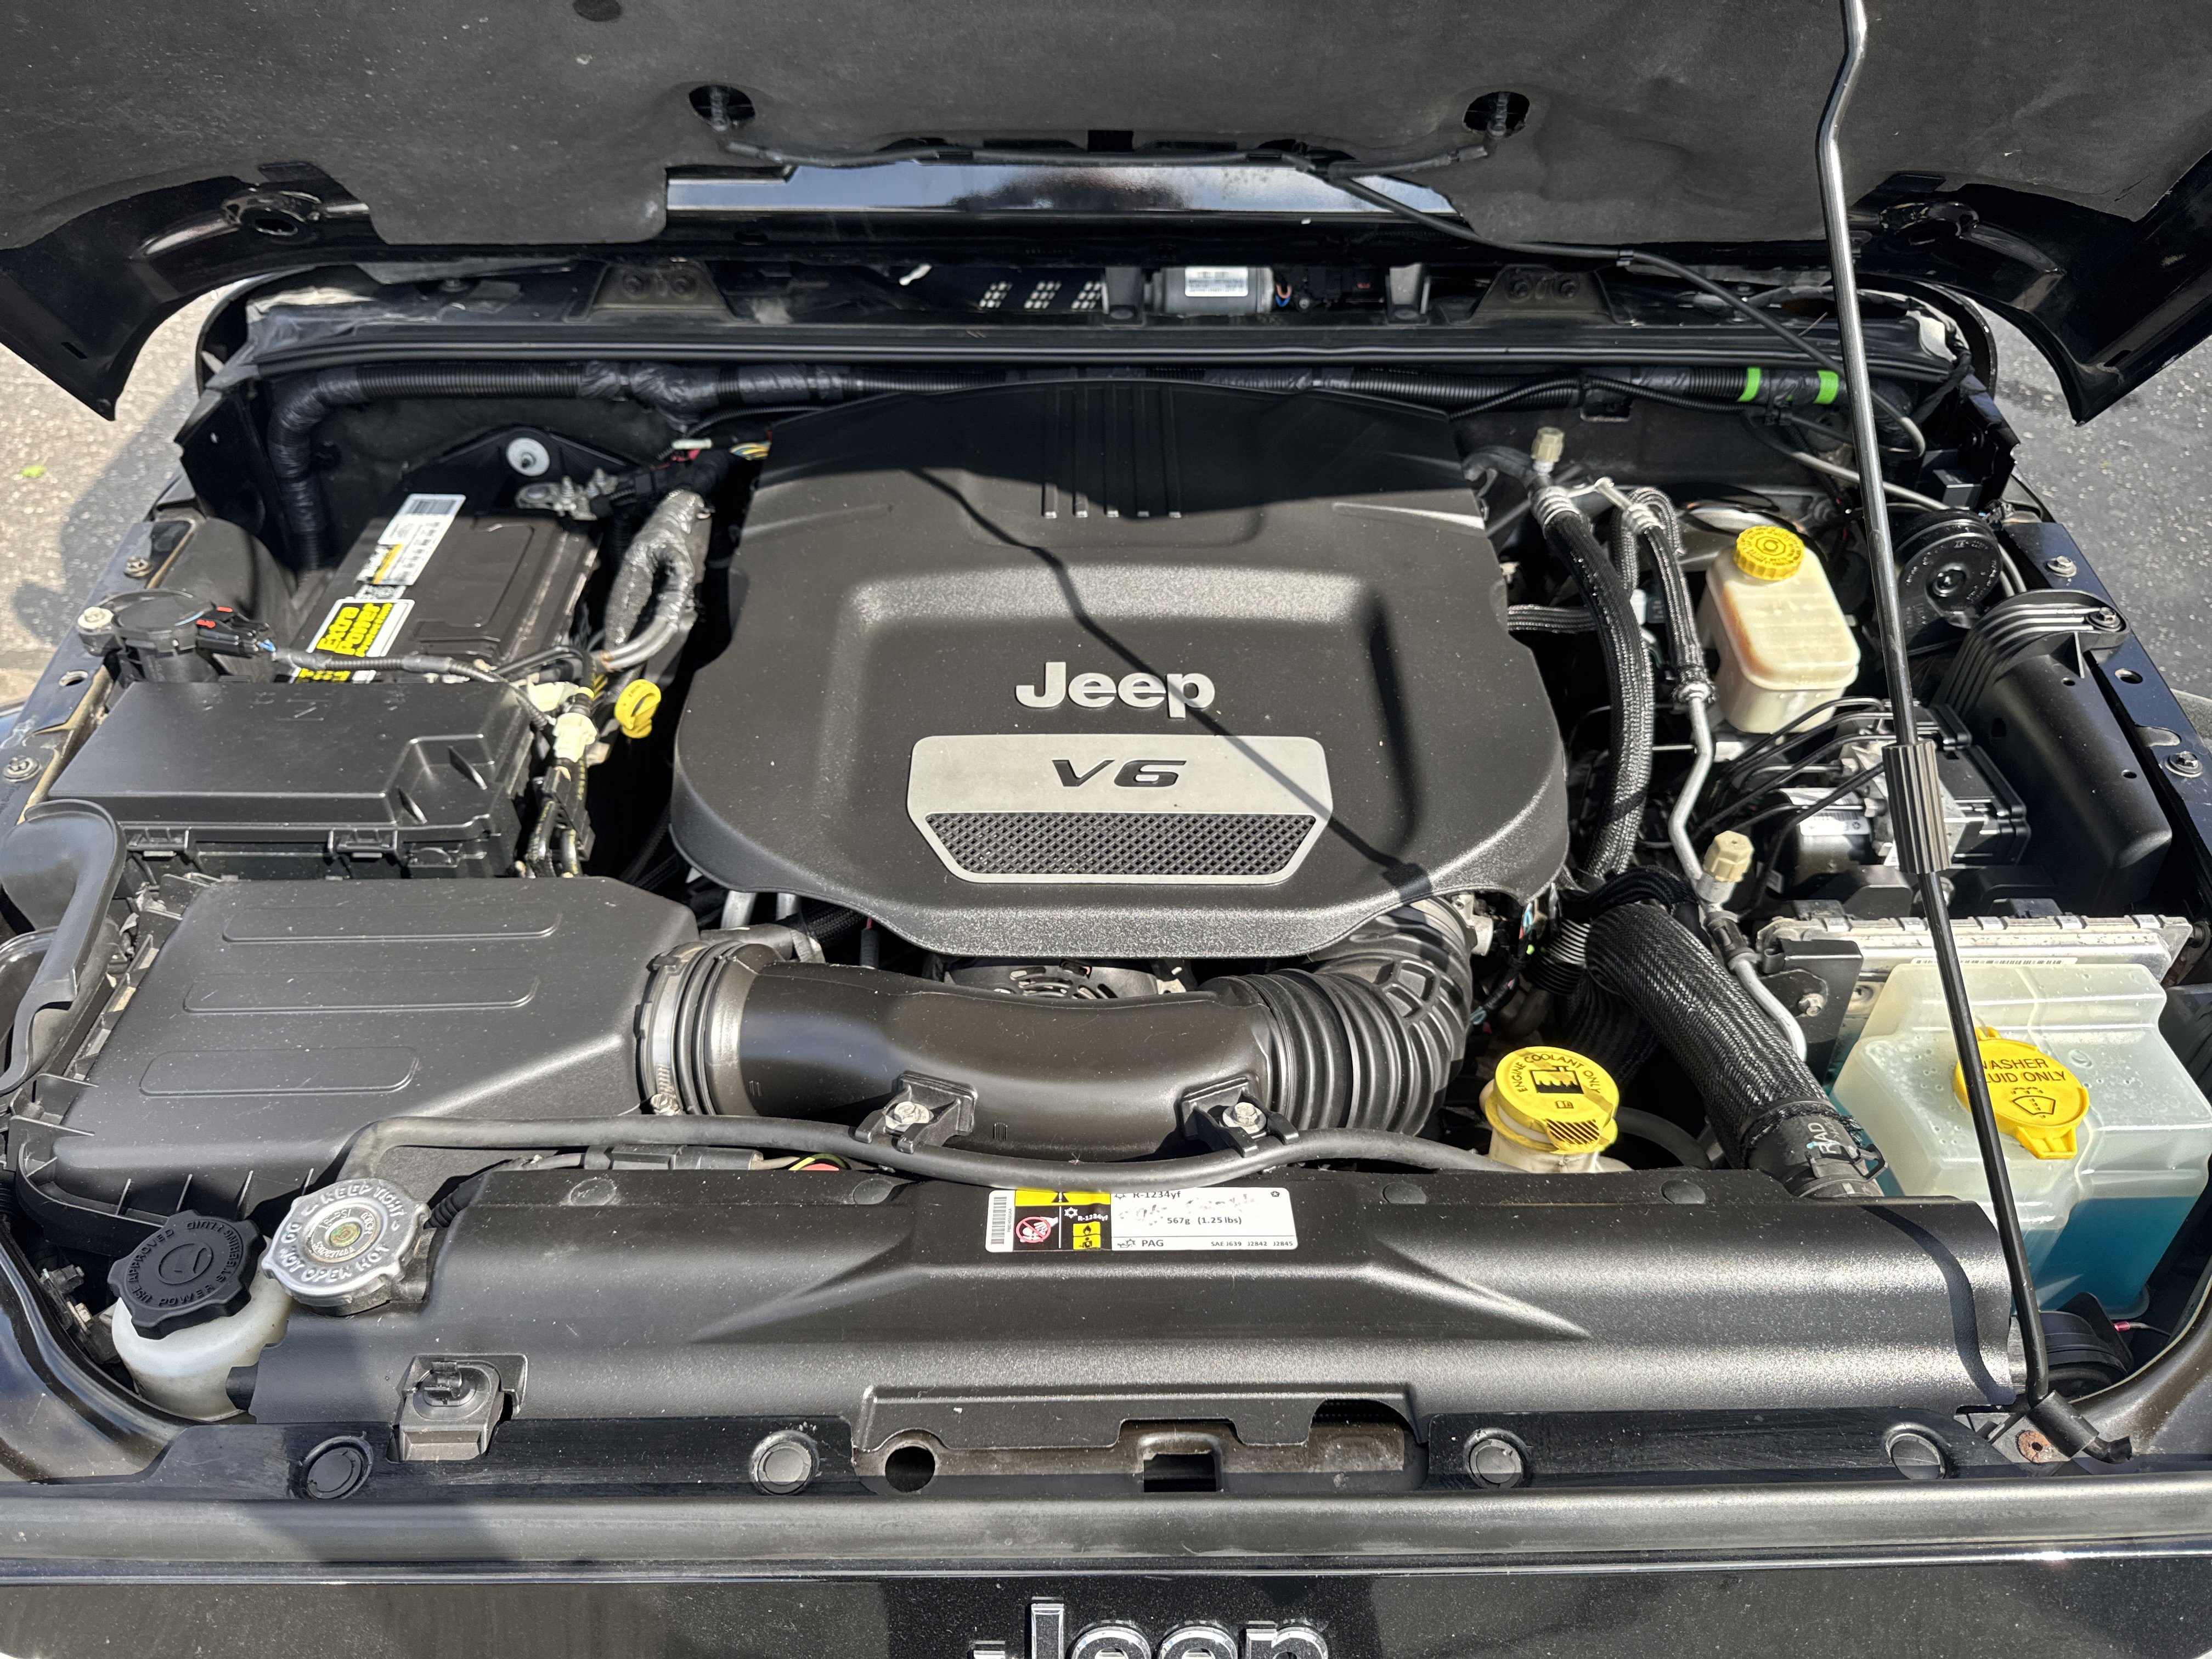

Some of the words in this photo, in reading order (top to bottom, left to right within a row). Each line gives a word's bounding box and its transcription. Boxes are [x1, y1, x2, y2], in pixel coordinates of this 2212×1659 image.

[1015, 662, 1216, 719] Jeep
[1052, 759, 1187, 787] V6
[1511, 1062, 1528, 1093] ENGINE
[1523, 1053, 1585, 1069] COOLANT
[1583, 1070, 1602, 1093] ONLY
[1986, 1072, 2018, 1084] UID
[2023, 1071, 2066, 1082] ONLY
[320, 1183, 373, 1204] KEEP
[1133, 1190, 1181, 1199] R-1234yf
[187, 1220, 225, 1233] FLUID
[1198, 1216, 1223, 1224] (1.25
[1224, 1216, 1242, 1224] lbs)
[128, 1228, 175, 1283] APPROVED
[215, 1229, 241, 1283] STEERING
[301, 1266, 353, 1283] OPEN
[355, 1245, 390, 1272] HOT
[132, 1285, 153, 1305] USE
[158, 1284, 215, 1307] POWER
